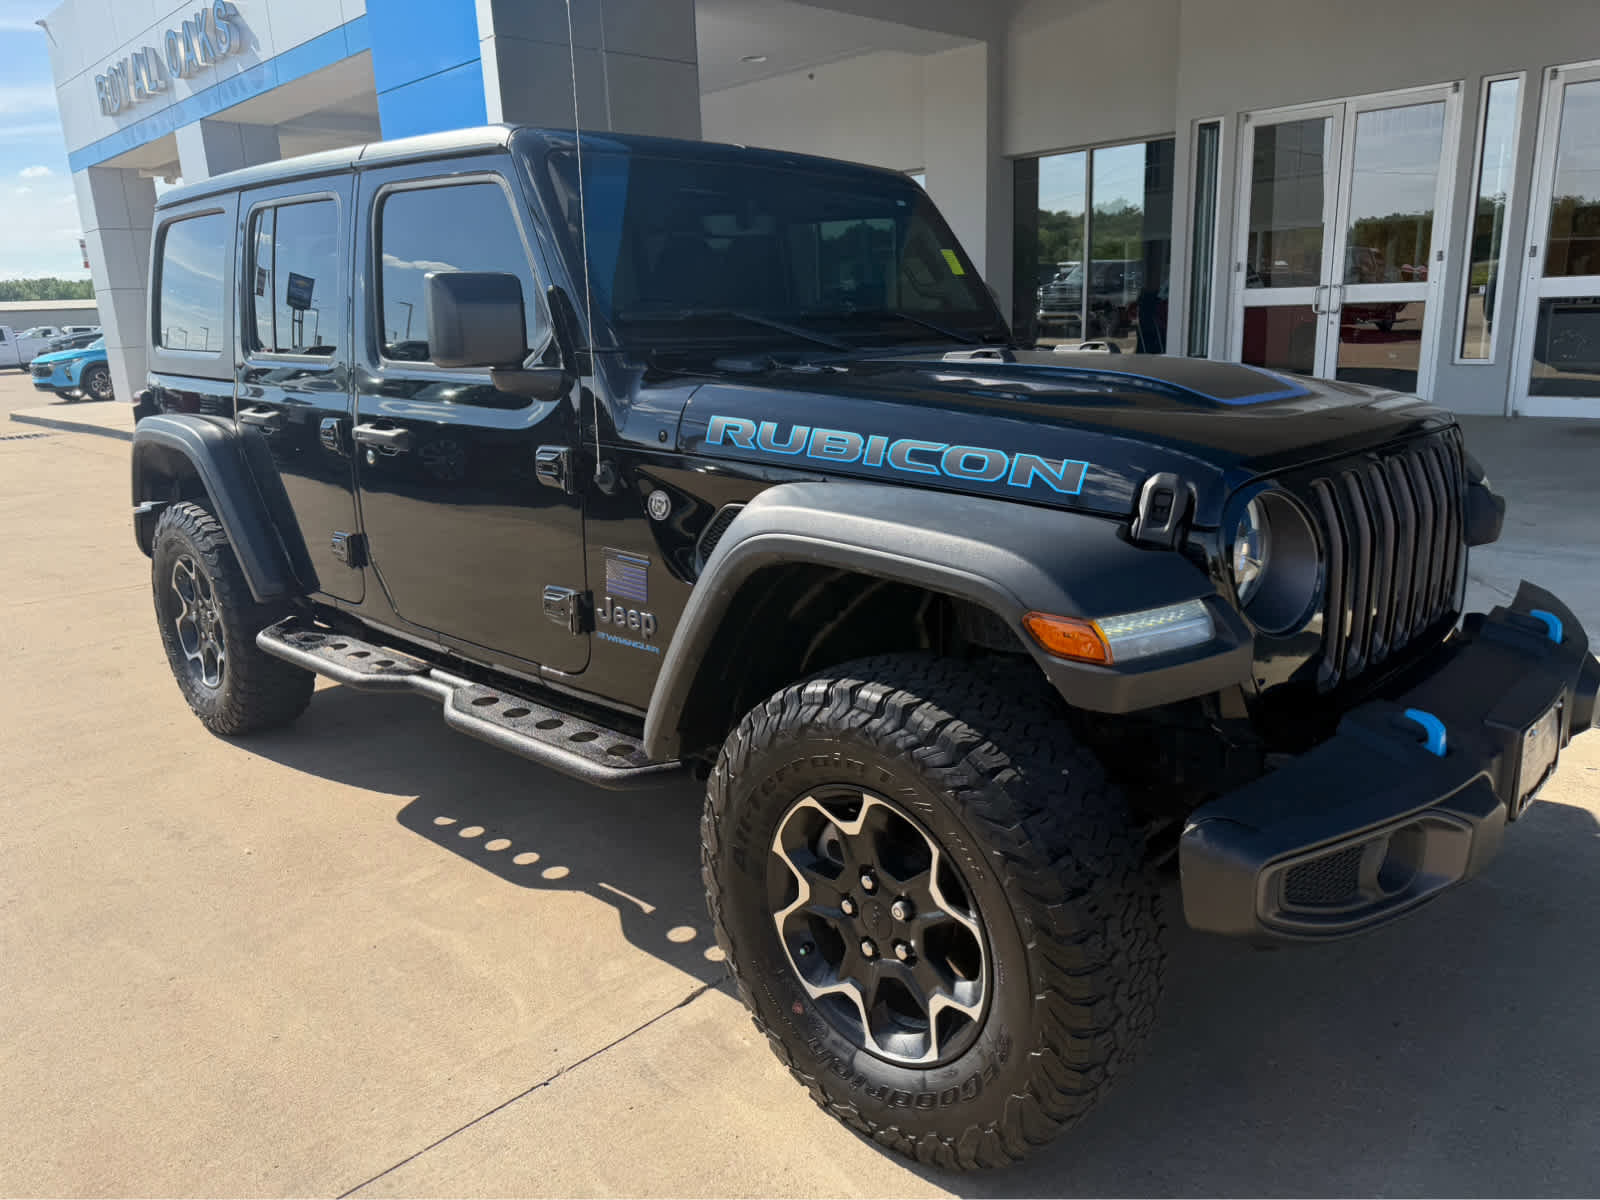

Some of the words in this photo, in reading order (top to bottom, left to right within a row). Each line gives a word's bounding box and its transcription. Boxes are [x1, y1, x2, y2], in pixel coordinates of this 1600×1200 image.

[95, 46, 160, 116] ROYAL
[165, 0, 234, 78] OAKS
[705, 415, 1089, 495] RUBICON
[597, 596, 657, 640] Jeep
